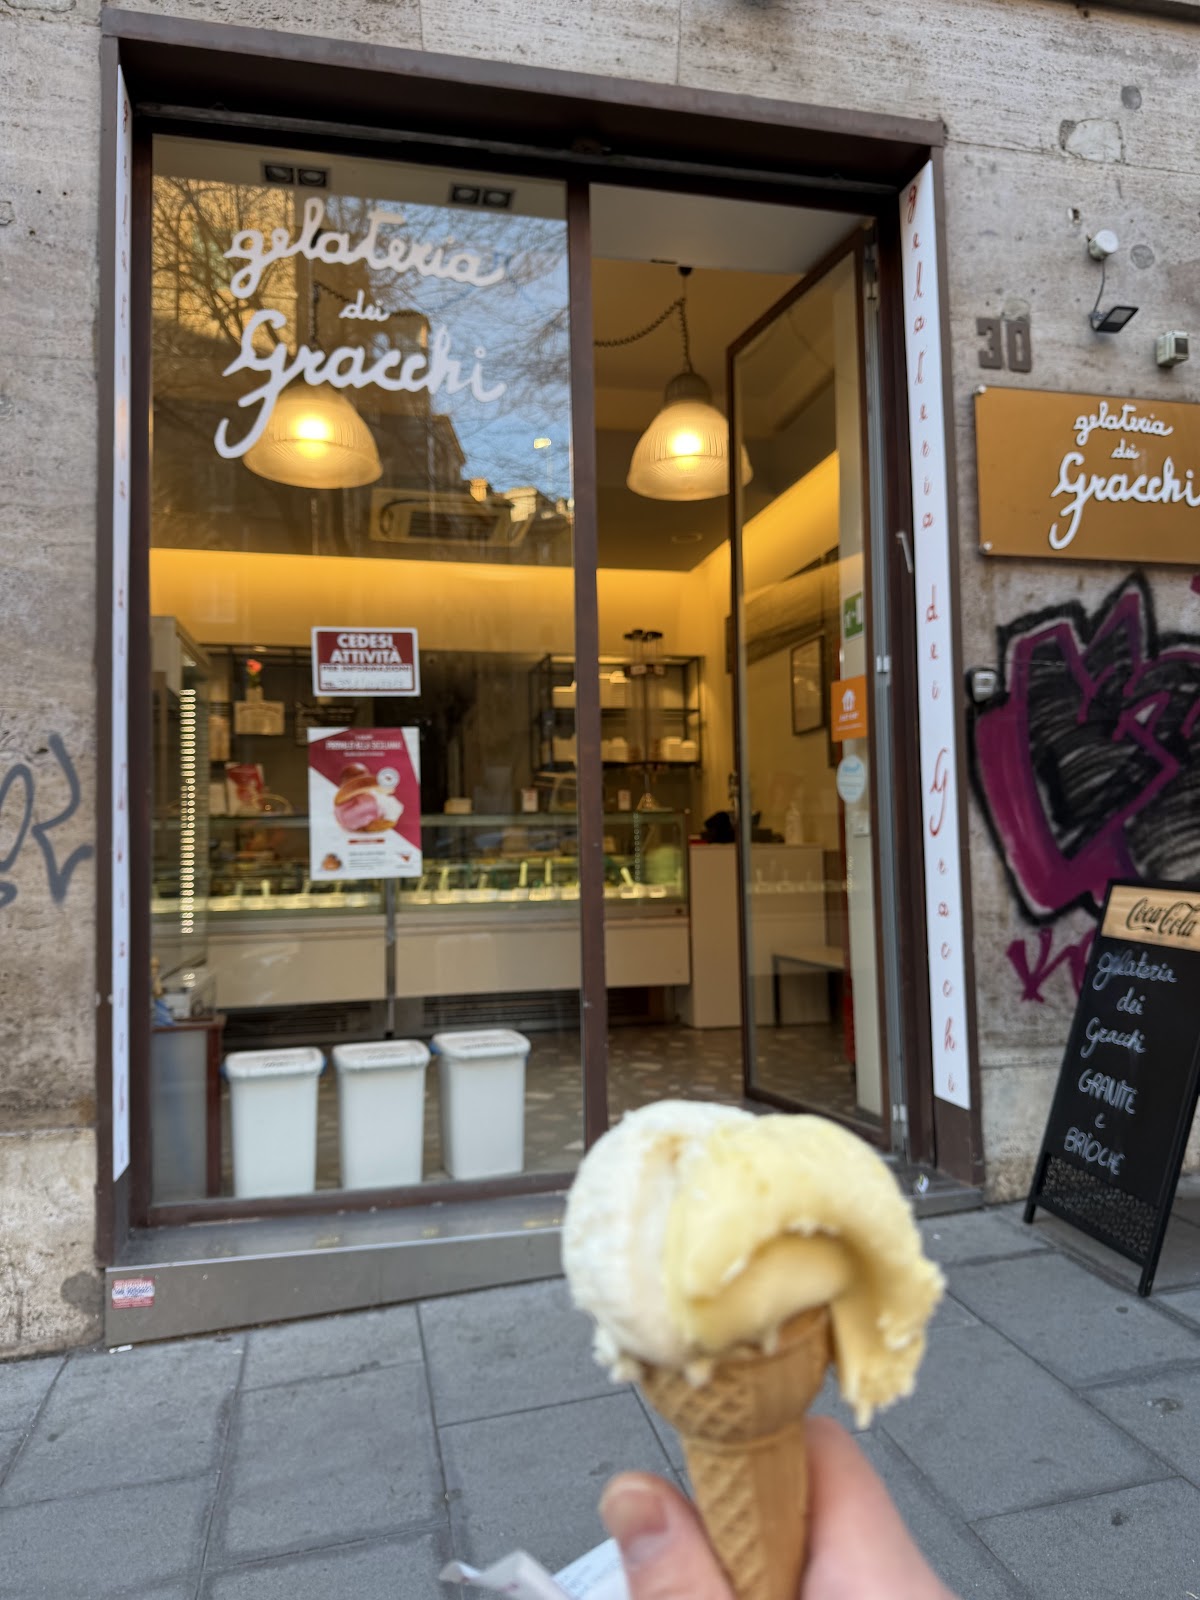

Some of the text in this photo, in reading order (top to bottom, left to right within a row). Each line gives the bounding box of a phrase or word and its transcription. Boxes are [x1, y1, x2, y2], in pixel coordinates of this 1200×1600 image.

[223, 197, 505, 299] gelateria
[339, 289, 391, 322] dei
[976, 317, 1032, 373] 30
[214, 309, 508, 459] Gracchi
[1073, 401, 1174, 446] gelateria
[1111, 438, 1141, 459] dei
[1048, 451, 1200, 550] Gracchi
[330, 645, 403, 664] ATTIVITÀ
[336, 633, 394, 649] CEDESI
[1116, 986, 1146, 1015] dei
[1080, 1016, 1146, 1058] Gracchi
